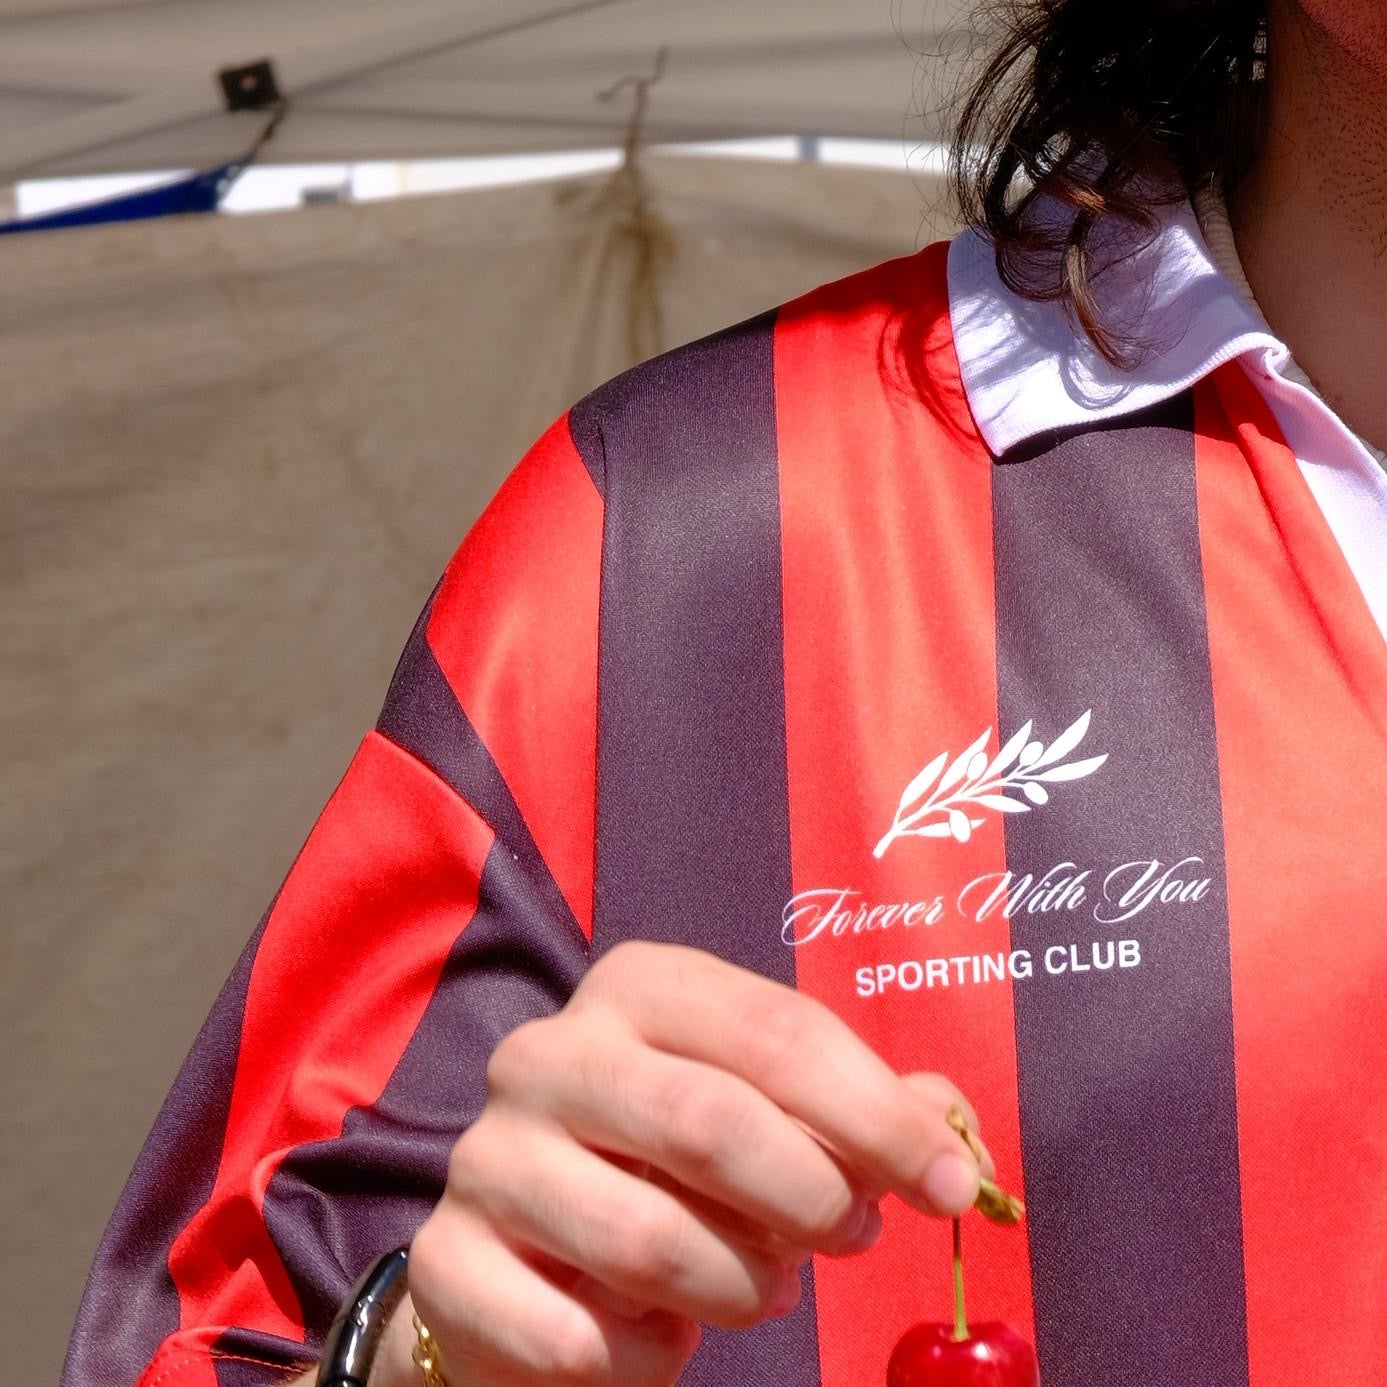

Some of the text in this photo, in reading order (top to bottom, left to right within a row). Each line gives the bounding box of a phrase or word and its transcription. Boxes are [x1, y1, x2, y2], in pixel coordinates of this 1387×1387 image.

[780, 856, 1213, 946] Forever With You
[855, 939, 1142, 997] SPORTING CLUB
